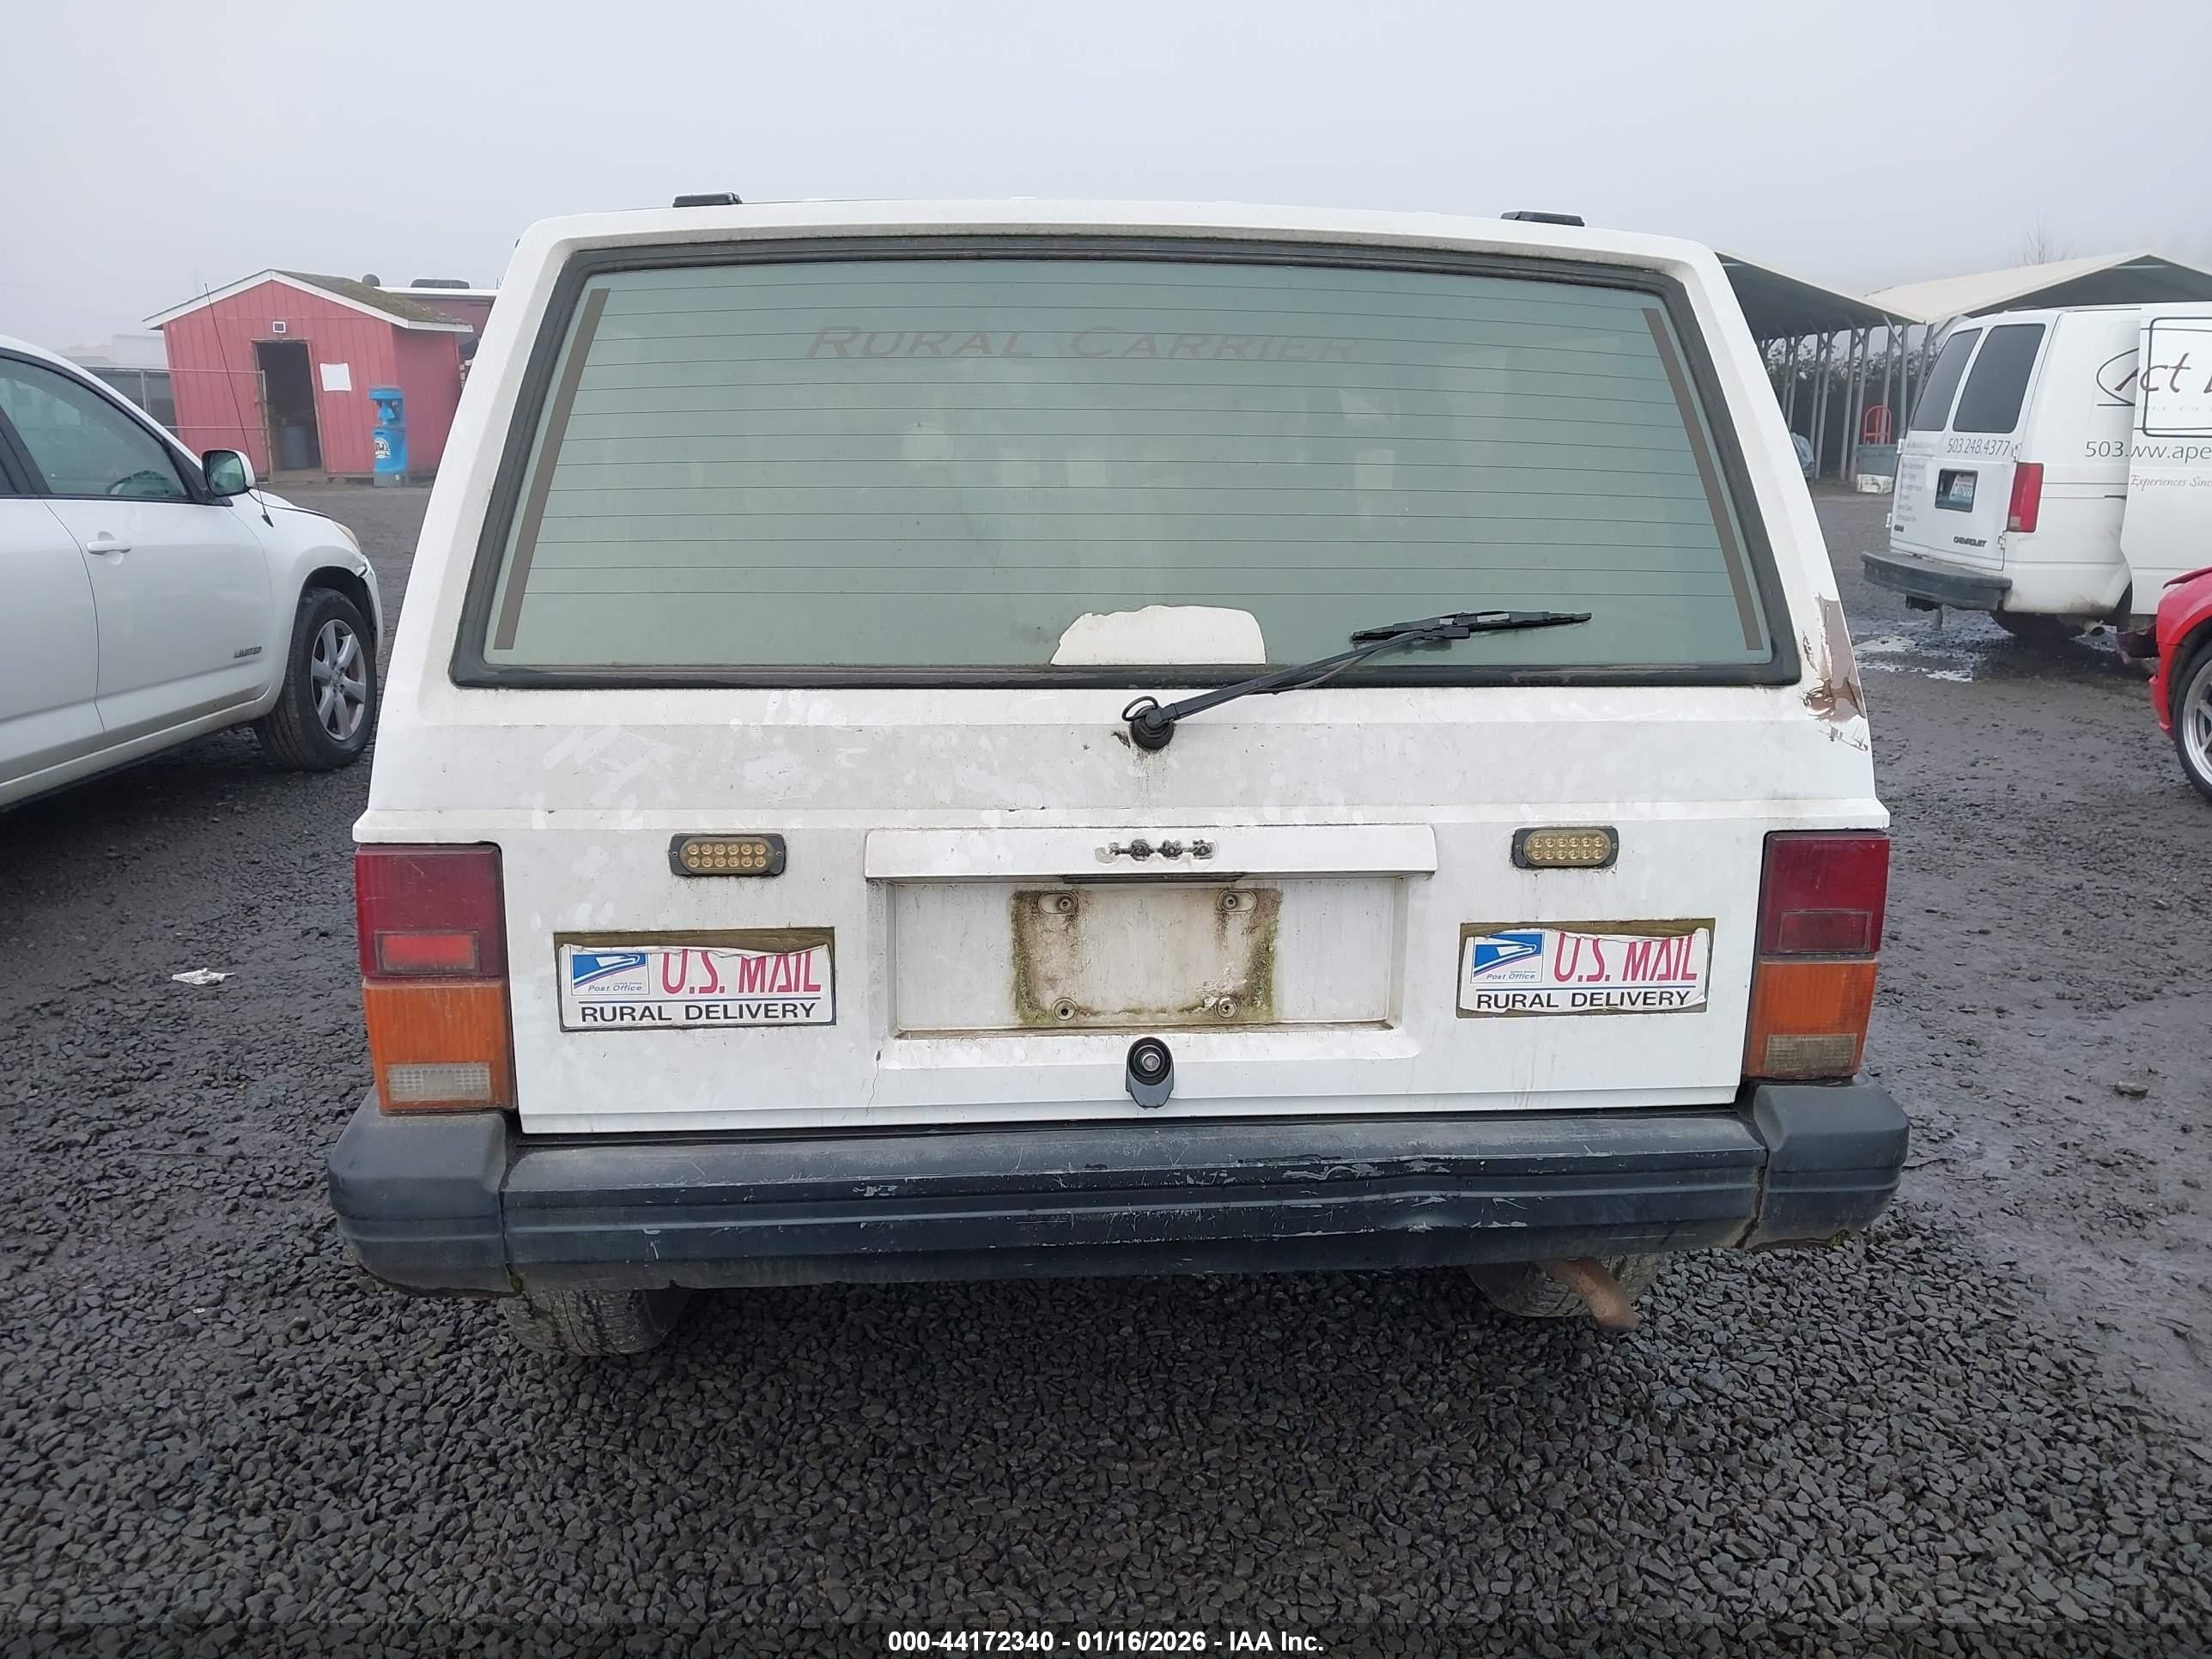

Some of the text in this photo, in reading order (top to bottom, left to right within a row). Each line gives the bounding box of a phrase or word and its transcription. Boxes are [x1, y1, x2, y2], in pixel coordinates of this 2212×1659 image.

[806, 325, 1361, 364] RURAL CARRIER
[1947, 438, 2010, 456] 503.248.4377
[2130, 474, 2186, 491] Experiences
[1554, 932, 1698, 982] U.S. MAIL
[662, 949, 821, 994] U.S. MAIL
[1477, 991, 1690, 1009] RURAL DELIVERY
[580, 1003, 816, 1023] RURAL DELIVERY
